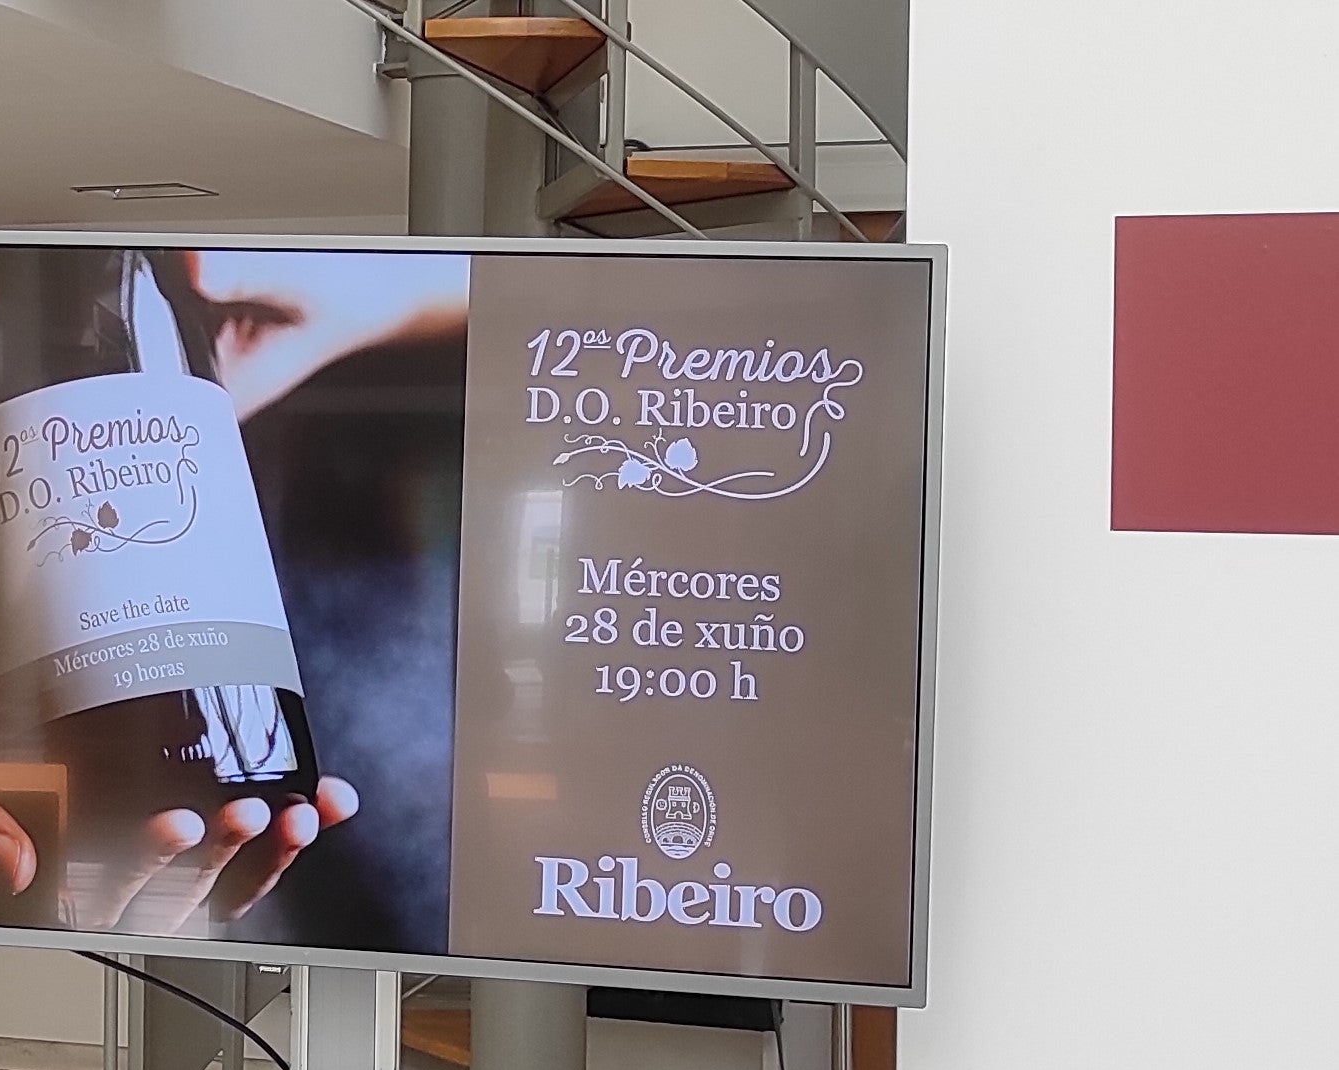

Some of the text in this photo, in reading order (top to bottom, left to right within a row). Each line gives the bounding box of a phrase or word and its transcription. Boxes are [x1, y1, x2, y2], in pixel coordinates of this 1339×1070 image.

[616, 328, 843, 384] Premios
[526, 387, 797, 430] D.O. Ribeiro
[42, 409, 187, 461] Premios
[67, 454, 172, 499] Ribeiro
[577, 557, 781, 602] Mércores
[79, 594, 190, 631] Save the date
[565, 607, 805, 653] 28 de xuño
[53, 626, 229, 678] Mércores 28 de xuño
[114, 659, 185, 689] 19 horas
[595, 661, 759, 702] 19:00 h
[533, 855, 822, 932] Ribeiro
